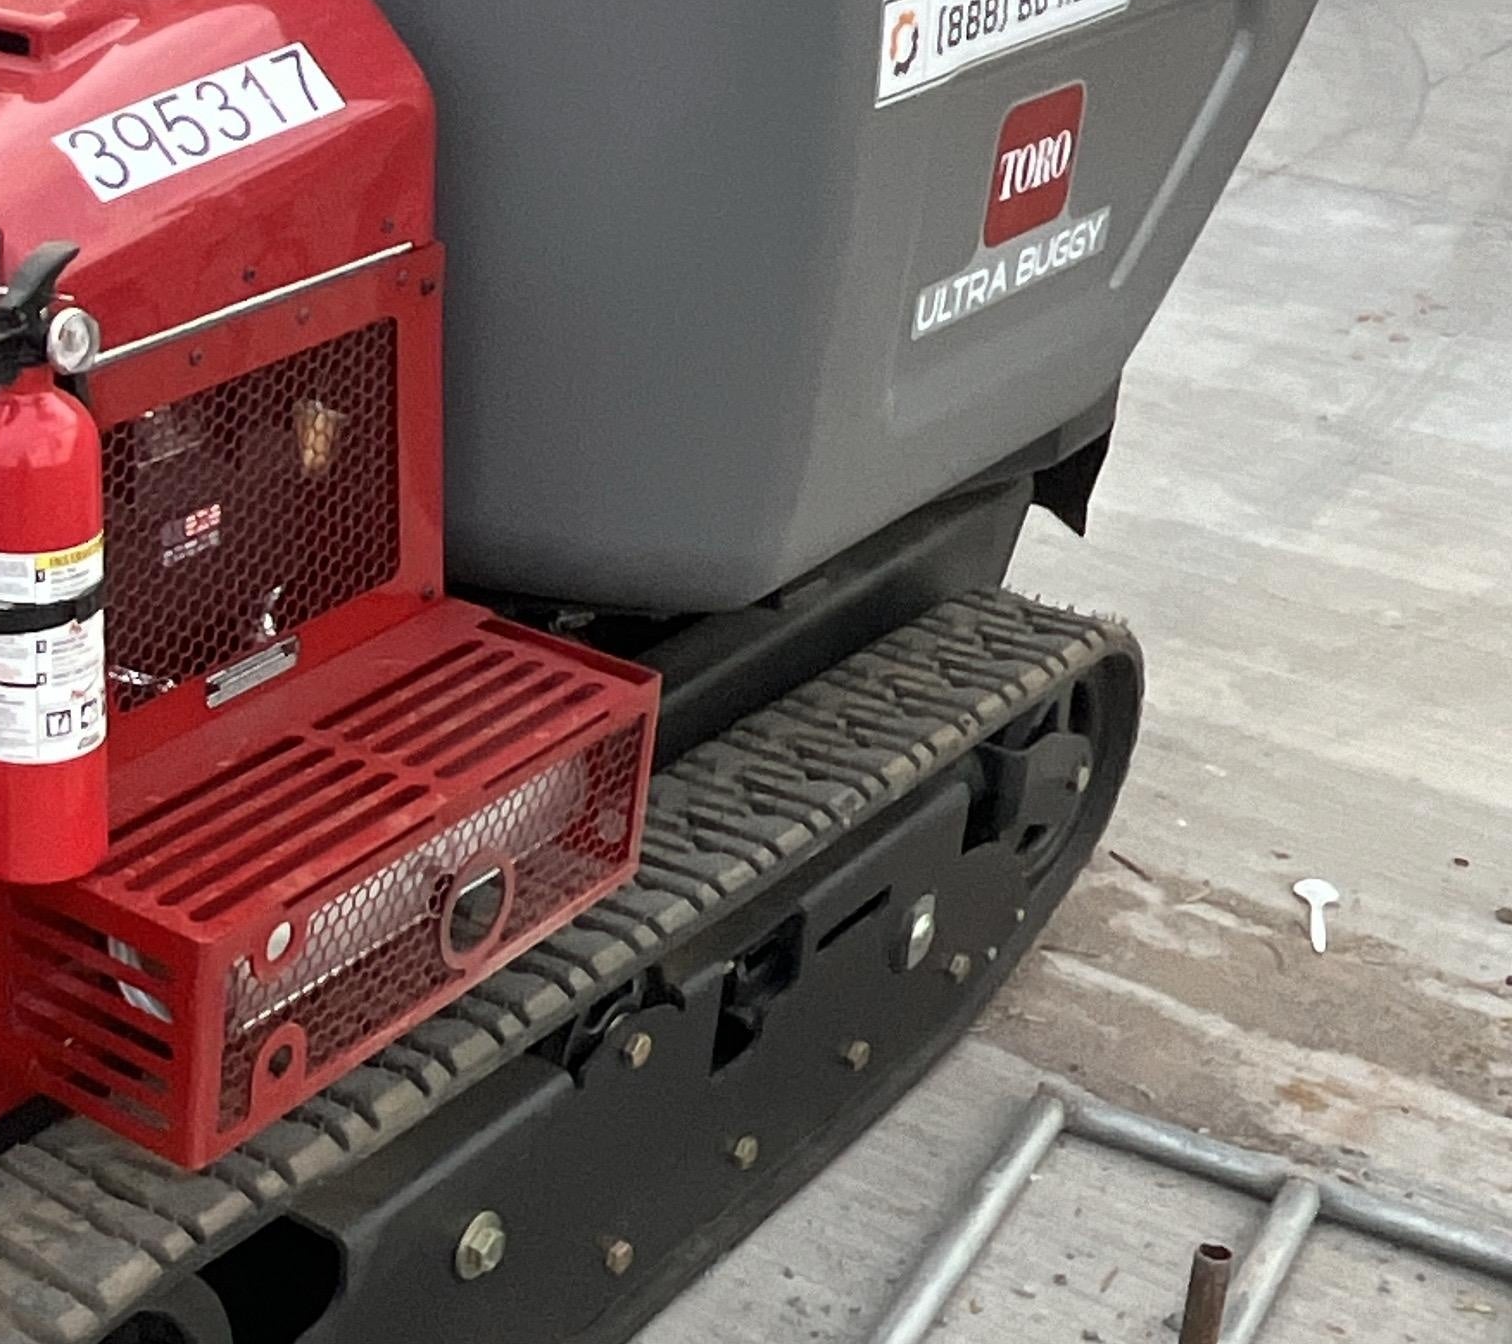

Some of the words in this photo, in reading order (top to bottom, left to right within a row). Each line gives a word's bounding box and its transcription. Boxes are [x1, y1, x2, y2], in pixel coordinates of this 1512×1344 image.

[68, 49, 319, 189] 395317
[998, 129, 1074, 202] TORO
[917, 261, 1008, 331] ULTRA
[1015, 214, 1105, 286] BUGGY
